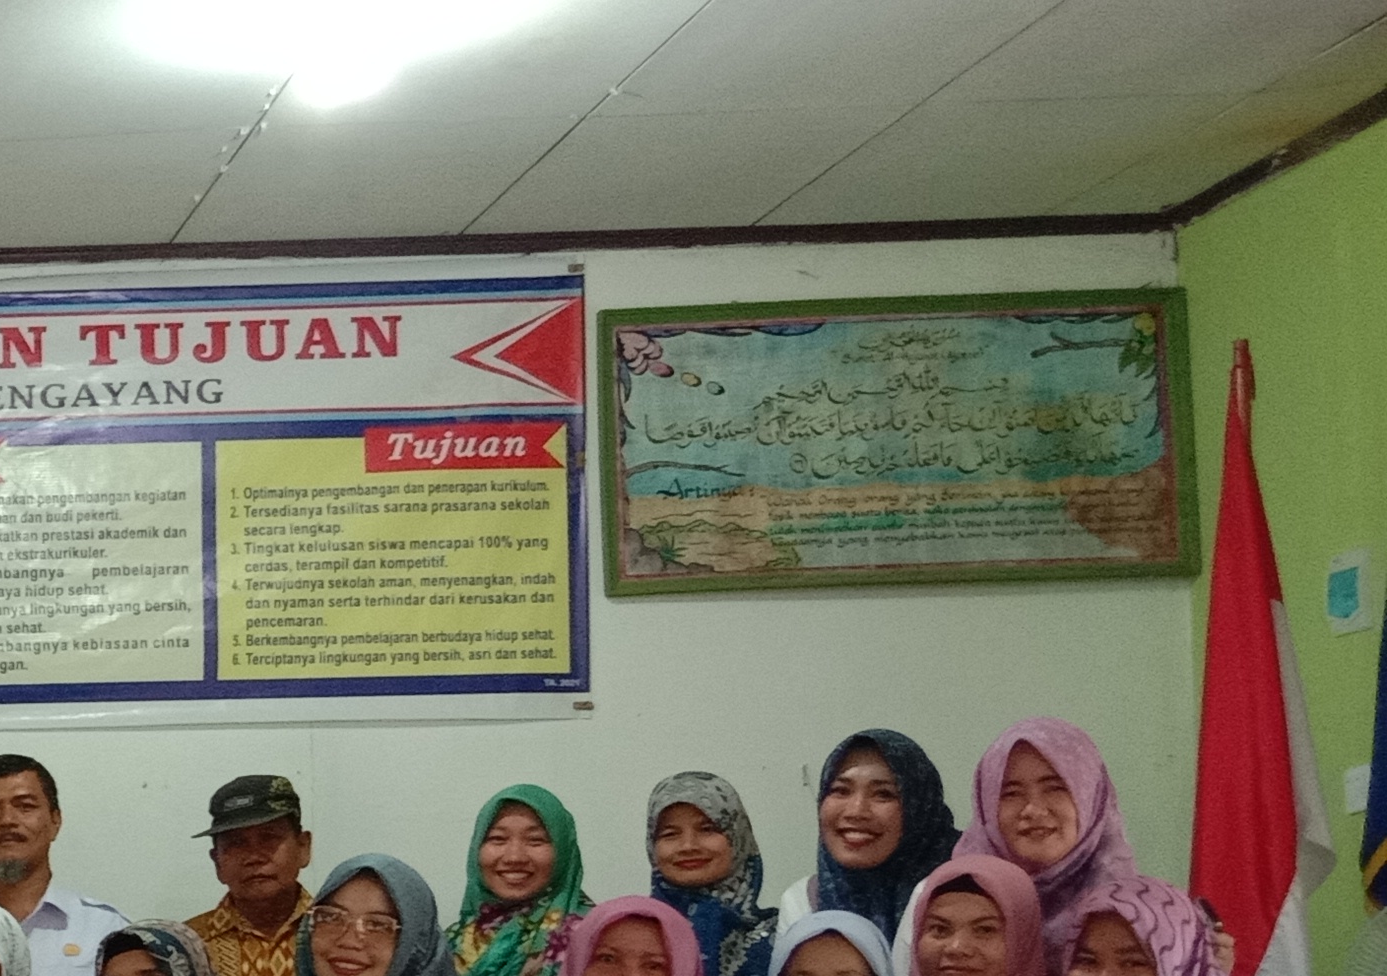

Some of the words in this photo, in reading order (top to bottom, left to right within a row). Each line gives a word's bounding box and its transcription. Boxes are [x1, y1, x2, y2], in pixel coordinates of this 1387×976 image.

[79, 315, 402, 366] TUJUAN
[388, 431, 526, 465] Tujuan
[431, 501, 496, 515] prasarana
[42, 530, 94, 543] prestasi
[98, 527, 159, 540] akademik
[164, 528, 186, 538] dan
[479, 536, 512, 548] 100%
[516, 536, 548, 551] yang
[353, 558, 376, 570] dan
[531, 593, 554, 603] dan
